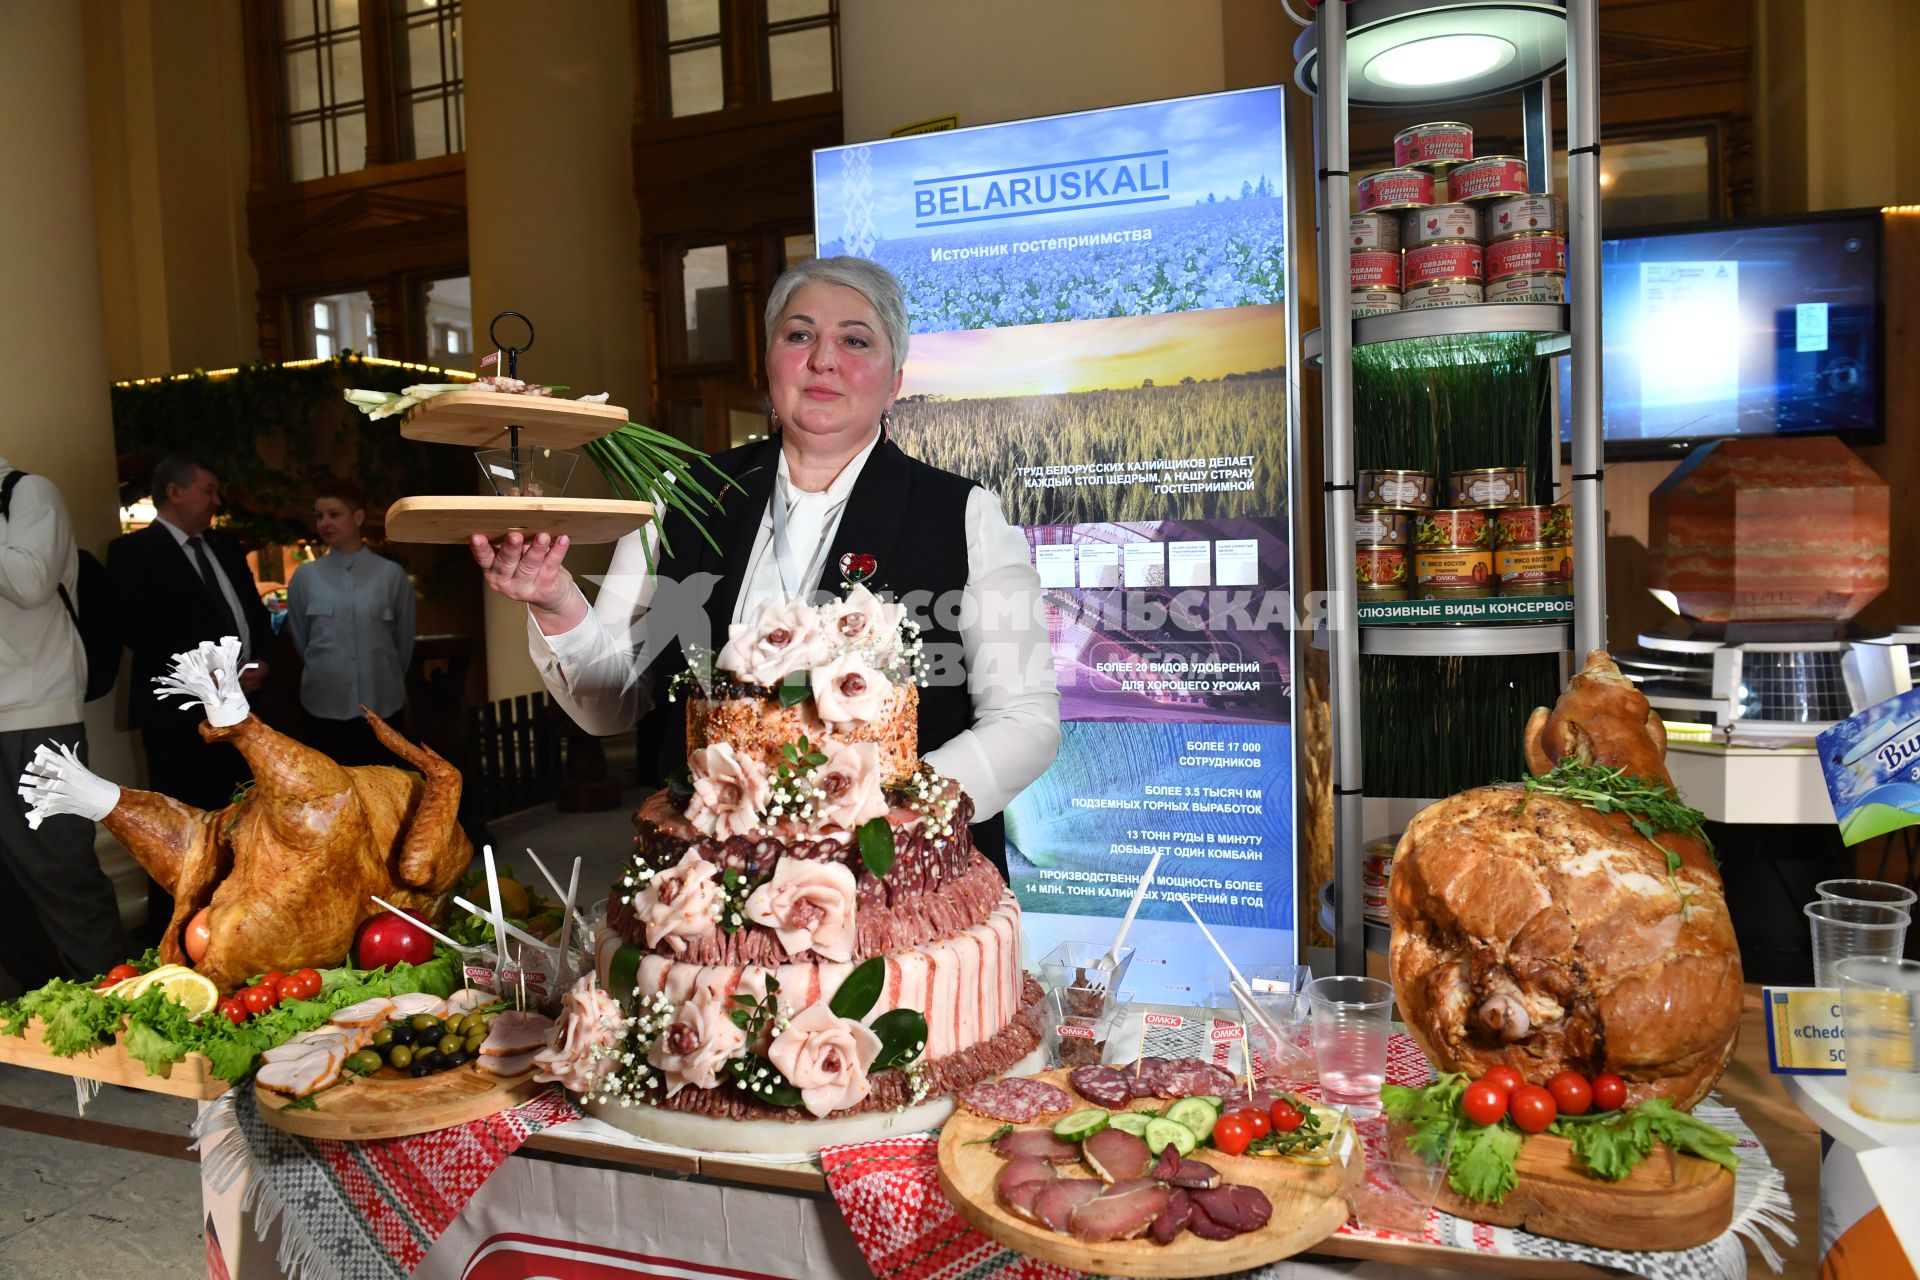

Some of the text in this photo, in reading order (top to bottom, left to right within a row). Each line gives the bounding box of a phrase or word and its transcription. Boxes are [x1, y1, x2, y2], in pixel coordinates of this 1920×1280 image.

[1424, 142, 1464, 151] СВИНИНА
[1460, 175, 1501, 189] СВИНИНА
[1460, 182, 1501, 194] ТУШЕНАЯ
[914, 161, 1169, 218] BELARUSKALI
[1379, 186, 1419, 196] СВИНИНА
[1379, 193, 1419, 202] ТУШЕНАЯ
[931, 228, 1153, 263] Источник гостеприимства
[1420, 258, 1457, 269] ГОВЯДИНА
[1503, 251, 1542, 263] ГОВЯДИНА
[1505, 259, 1541, 269] ТУШЕНАЯ
[1351, 267, 1383, 275] ОВЯДИНА
[1421, 266, 1455, 276] ТУШЕНАЯ
[1017, 456, 1255, 477] ТРУД БЕЛОРУССКИХ КАЛИЙЩИКОВ ДЕЛАЕТ
[1024, 468, 1255, 488] КАЖДЫЙ СТОЛ ЩЕДРЫМ, А НАШУ СТРАНУ
[1154, 479, 1255, 494] ГОСТЕПРИИМНОЙ
[1357, 601, 1574, 618] КЛЮЗИВНЫЕ ВИДЫ КОНСЕРВОВ
[1096, 660, 1260, 674] БОЛЕЕ 20 ВИДОВ УДОБРЕНИЙ
[1121, 680, 1260, 691] ДЛЯ ХОРОШЕГО УРОЖАЯ
[1187, 741, 1261, 752] БОЛЕЕ 17 000
[1878, 734, 1920, 770] Ви
[1179, 756, 1261, 768] СОТРУДНИКОВ
[1145, 785, 1262, 799] БОЛЕЕ 3.5 ТЫСЯЧ КМ
[1071, 798, 1262, 815] ПОДЗЕМНЫХ ГОРНЫХ ВЫРАБОТОК
[1126, 830, 1262, 845] 13 ТОНН РУДЫ В МИНУТУ
[1110, 844, 1263, 860] ДОБЫВАЕТ ОДИН КОМБАЙН
[1039, 870, 1263, 891] ПРОИЗВОДСТВЕННЯ МОЩНОСТЬ БОЛЕЕ
[1025, 883, 1264, 908] 14 МЛН. ТОНН КАЛИЙЫХ УДОБРЕНИЙ В ГОД
[1147, 1015, 1178, 1026] ОМКК
[1061, 1027, 1090, 1037] ОМКК
[1213, 1028, 1241, 1039] ОМКК
[1794, 1025, 1845, 1039] «Ched
